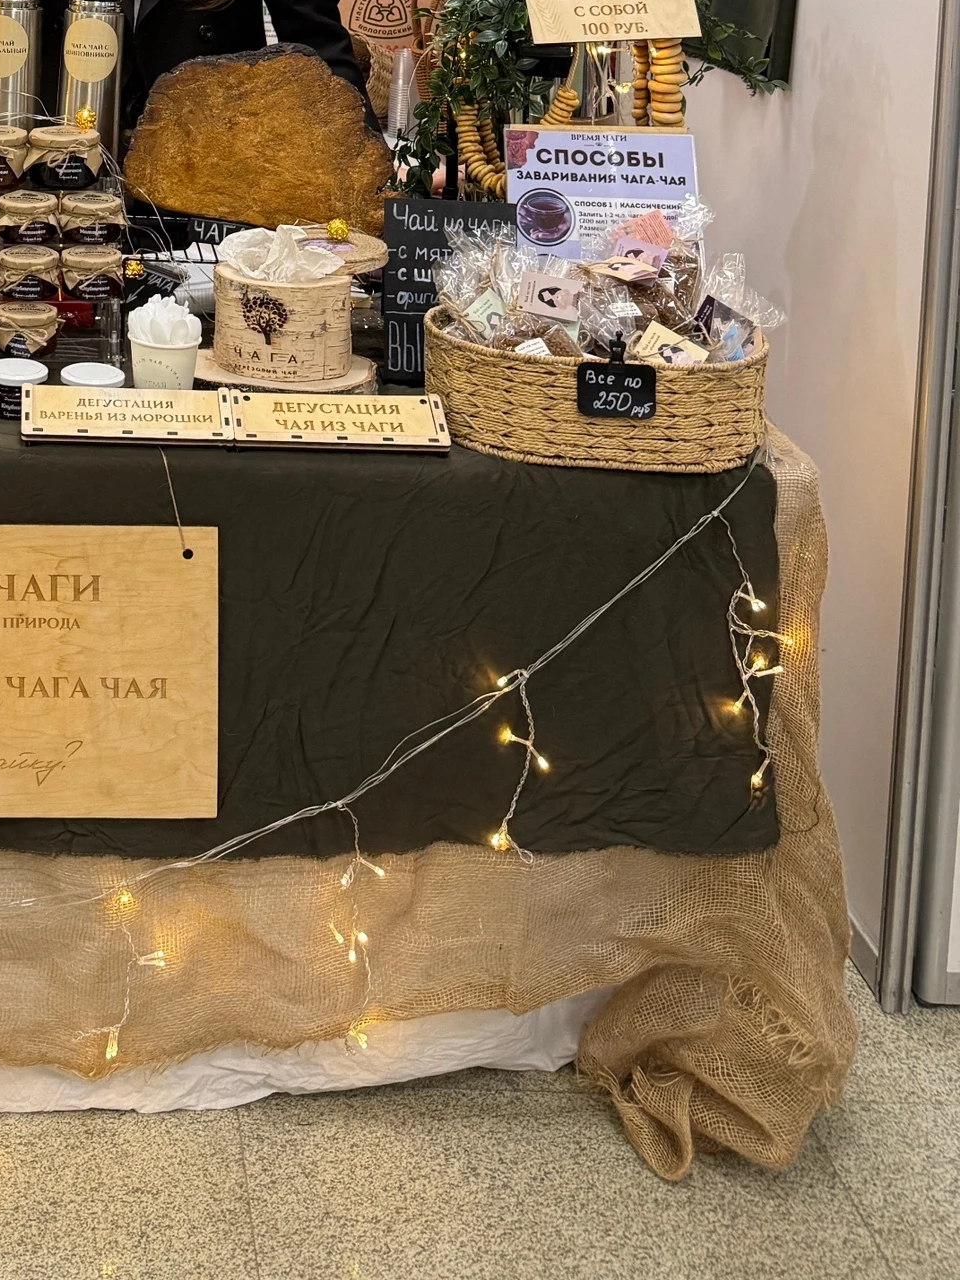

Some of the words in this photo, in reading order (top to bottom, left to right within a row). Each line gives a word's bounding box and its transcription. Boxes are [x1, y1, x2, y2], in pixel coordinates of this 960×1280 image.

[573, 4, 586, 18] С
[589, 0, 649, 17] СОБОЙ
[581, 22, 609, 36] 100
[615, 21, 649, 36] РУБ.
[571, 133, 601, 142] ВРЕМЯ
[603, 134, 627, 142] ЧАГИ
[536, 148, 664, 168] СПОСОБЫ
[516, 171, 617, 184] ЗАВАРИВАНИЯ
[621, 174, 686, 186] ЧАГА-ЧАЯ
[620, 202, 682, 210] КЛАССИЧЕСКИЙ
[393, 203, 439, 232] Чай
[194, 220, 245, 243] ЧАГ
[234, 346, 297, 364] ЧАГА
[586, 370, 615, 385] Все
[624, 378, 641, 388] по
[76, 396, 174, 410] ДЕГУСТАЦИЯ
[272, 400, 401, 417] ДЕГУСТАЦИЯ
[593, 391, 632, 411] 250
[630, 402, 653, 417] руб
[39, 409, 104, 424] ВАРЕНЬЯ
[107, 411, 127, 423] ИЗ
[131, 412, 214, 425] МОРОШКИ
[275, 418, 318, 431] ЧАЯ
[320, 419, 346, 432] ИЗ
[351, 420, 405, 433] ЧАГИ
[2, 617, 81, 632] ПРИРОДА
[5, 676, 91, 700] ЧАГА
[99, 677, 168, 700] ЧАЯ
